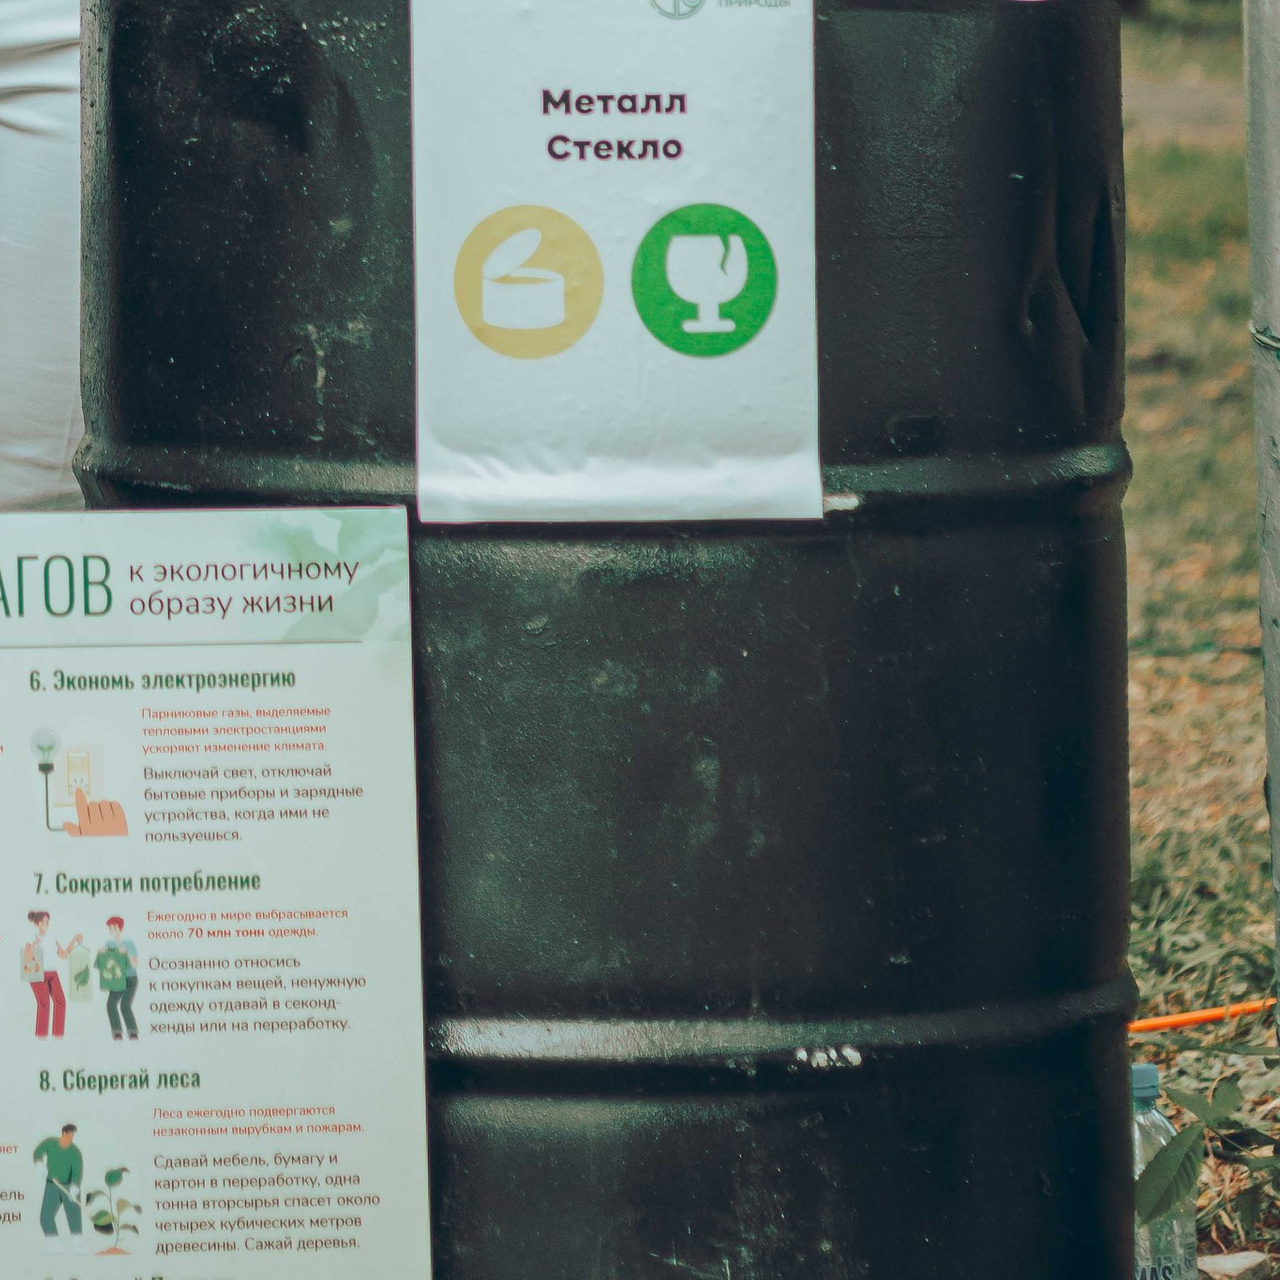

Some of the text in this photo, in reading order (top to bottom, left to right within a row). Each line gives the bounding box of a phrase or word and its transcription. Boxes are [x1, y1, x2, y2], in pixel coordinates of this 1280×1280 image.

[542, 89, 687, 115] Металл
[547, 134, 683, 161] Стекло
[129, 561, 360, 585] к экологичному
[129, 590, 334, 620] образу жизни
[29, 668, 296, 693] 6. Экономь электроэнергию
[141, 707, 218, 721] Парниковые
[255, 707, 330, 719] выделяемые
[142, 725, 326, 737] тепловыми электростанциями
[142, 744, 200, 755] ускоряют
[204, 743, 270, 752] изменение
[143, 763, 331, 780] Выключай свет, отключай
[144, 785, 363, 802] бытовые приборы и зарядные
[144, 807, 329, 824] устройства, когда ими не
[145, 830, 242, 844] пользуешься.
[34, 869, 260, 898] 7. Сократи потребление
[147, 930, 183, 939] около
[188, 927, 203, 938] 70
[206, 929, 231, 938] млн
[234, 928, 264, 937] тонн
[148, 956, 300, 970] Осознанно относись
[149, 975, 366, 993] к покупкам вещей, ненужную
[149, 1001, 204, 1014] одежду
[208, 996, 267, 1013] отдавай
[272, 1000, 280, 1009] в
[150, 1016, 350, 1035] хенды или на переработку.
[39, 1067, 200, 1095] 8. Сберегай леса
[153, 1151, 338, 1170] Сдавай мебель, бумагу и
[154, 1172, 360, 1192] картон в переработку, одна
[154, 1195, 380, 1212] тонна вторсырья спасет около
[155, 1214, 362, 1234] четырех кубических метров
[155, 1236, 360, 1255] древесины. Сажай деревья.
